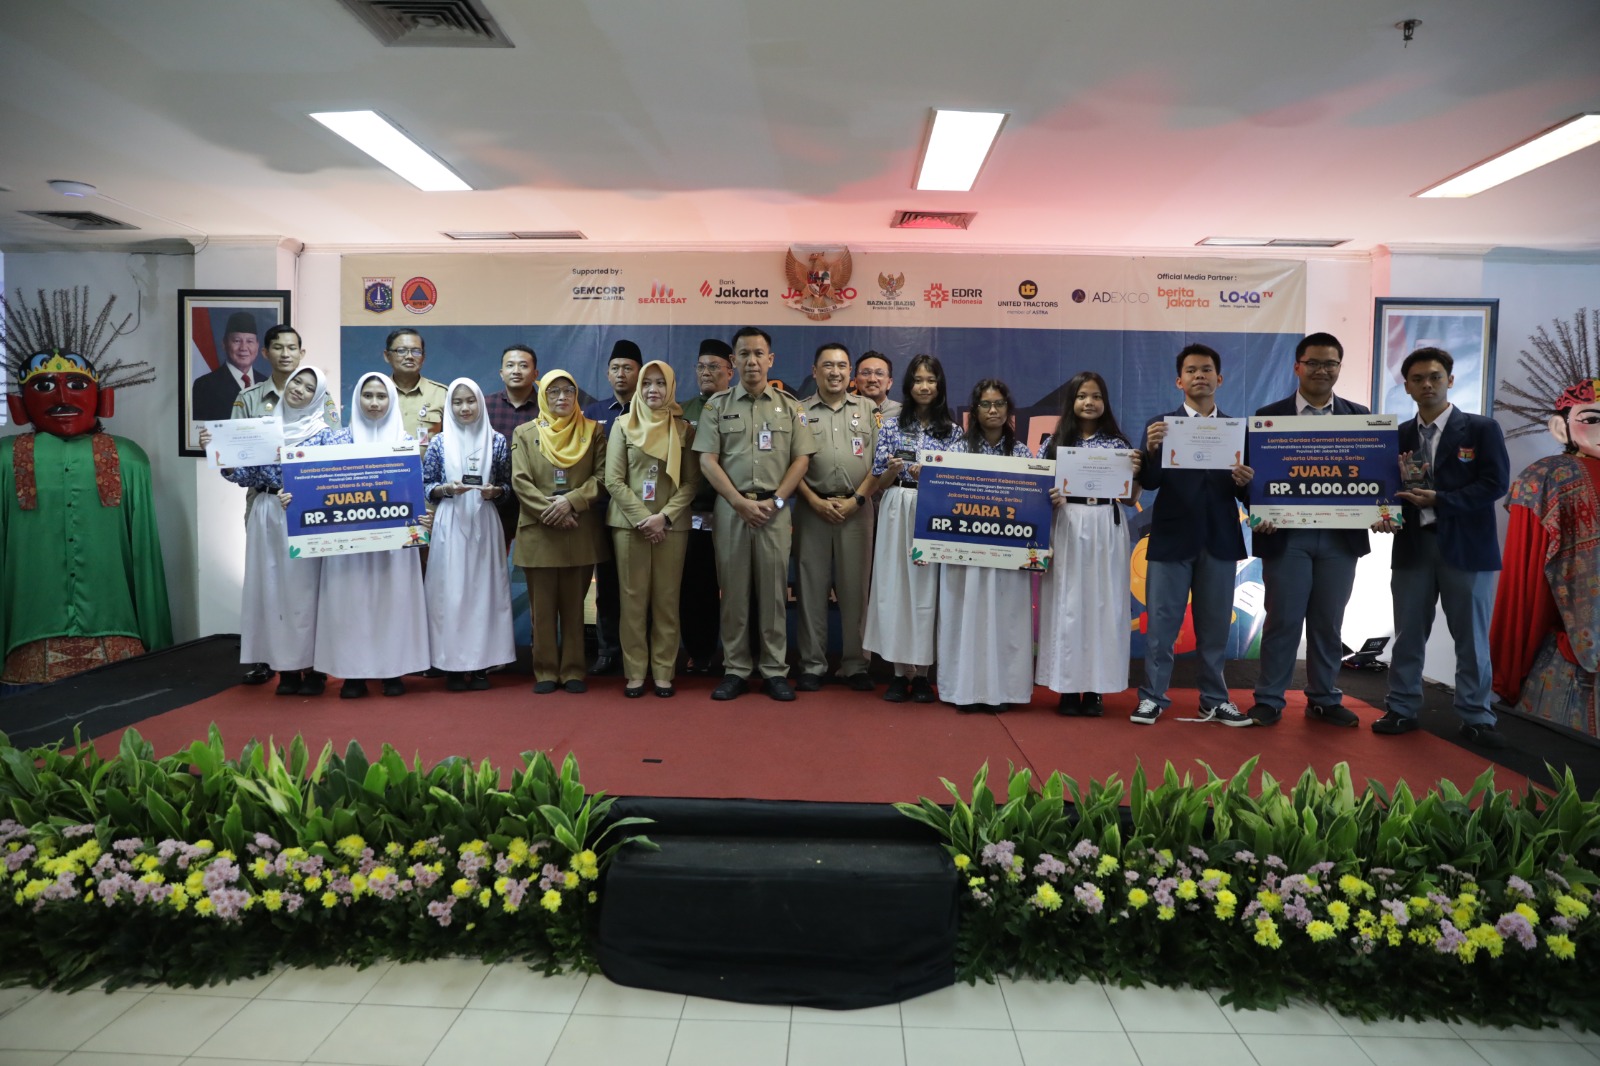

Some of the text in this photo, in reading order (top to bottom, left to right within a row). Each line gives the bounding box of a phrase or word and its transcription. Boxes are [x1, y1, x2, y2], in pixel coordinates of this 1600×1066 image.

[572, 268, 609, 276] Supported
[610, 268, 619, 276] by
[572, 286, 625, 295] GEMCORP
[715, 287, 769, 298] Jakarta
[951, 288, 982, 297] EDRR
[1157, 287, 1194, 298] berita
[1092, 292, 1150, 304] ADEXCO
[1166, 297, 1210, 309] jakarta
[1288, 465, 1359, 478] JUARA 3
[998, 478, 1037, 486] Kebencanaan
[1269, 482, 1379, 495] RP. 1.000.000
[324, 490, 388, 506] JUARA 1
[304, 504, 409, 526] RP. 3.000.000
[952, 502, 1016, 520] JUARA 2
[931, 517, 1033, 538] RP. 2.000.000
